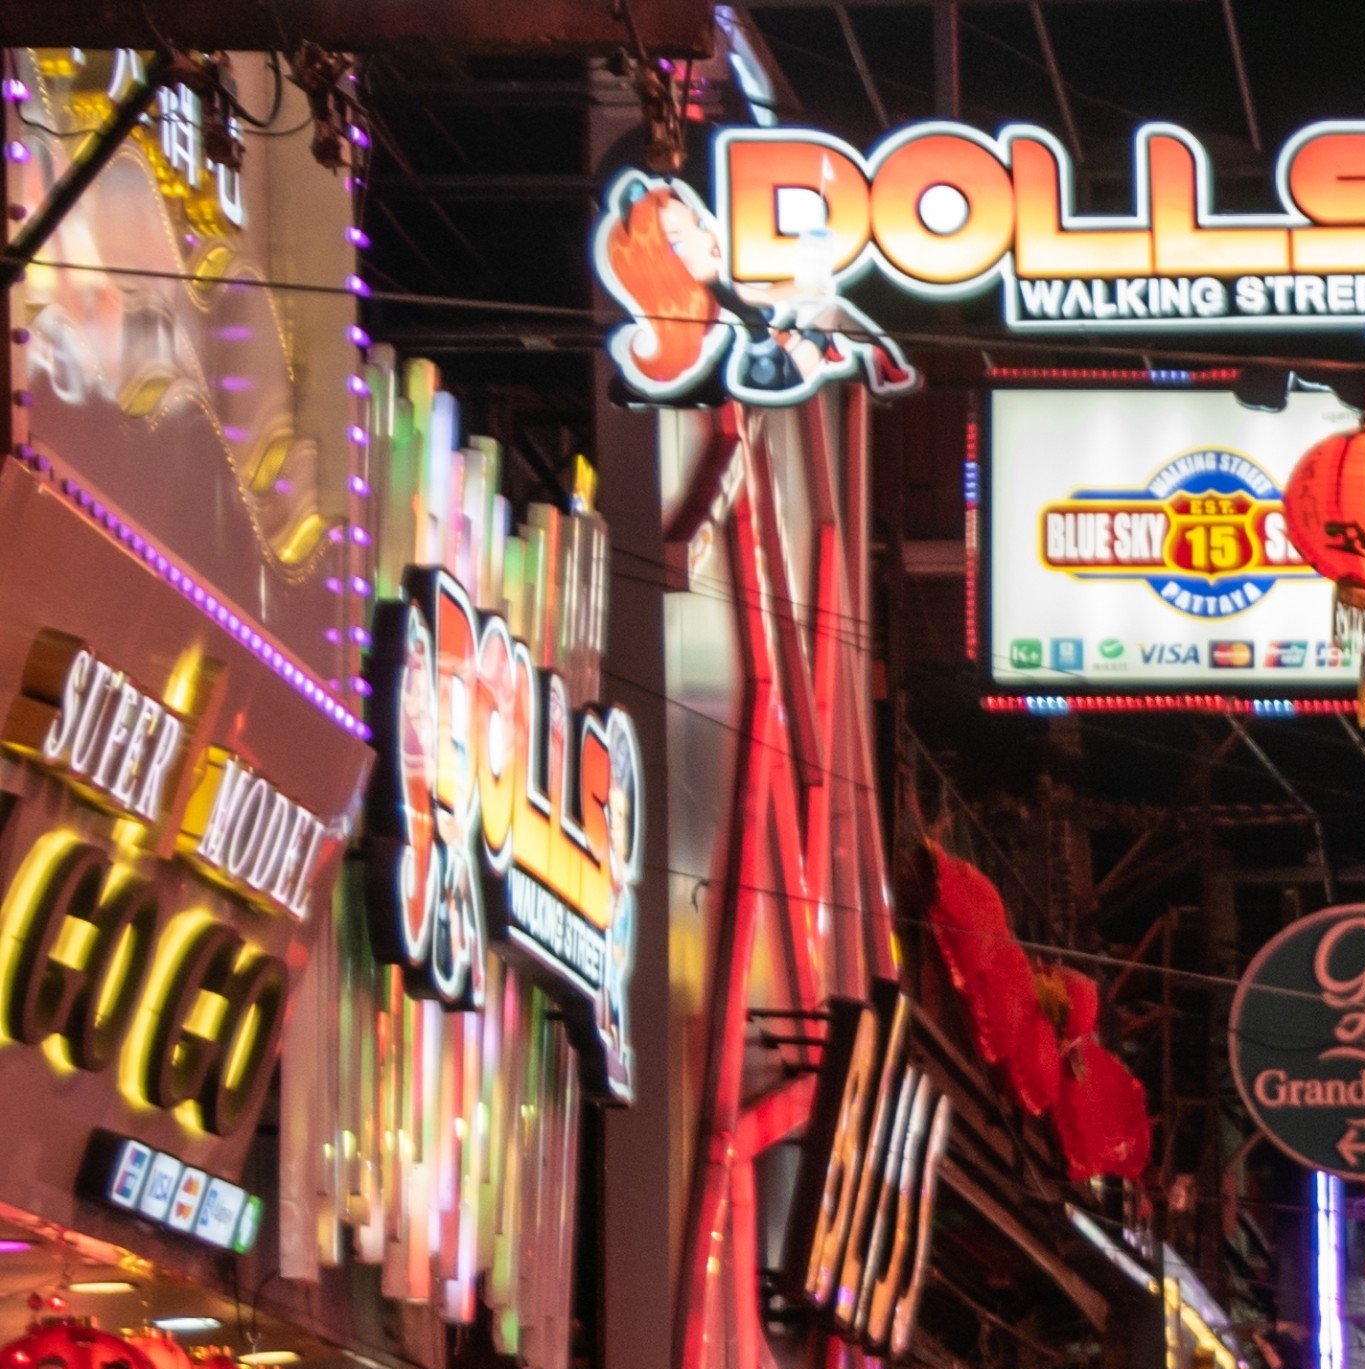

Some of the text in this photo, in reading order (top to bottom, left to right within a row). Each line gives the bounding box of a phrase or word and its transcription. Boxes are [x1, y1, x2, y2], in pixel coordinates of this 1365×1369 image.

[1021, 277, 1230, 317] WALKING
[1149, 450, 1274, 498] WALKING STREET
[1189, 498, 1236, 516] EST.
[1046, 511, 1168, 563] BLUE SKY
[1185, 524, 1240, 568] 15
[1160, 580, 1264, 616] PATTAYA
[1138, 643, 1201, 665] VISA
[44, 649, 328, 923] SUPER MODEL
[510, 868, 608, 989] WALKING STREET
